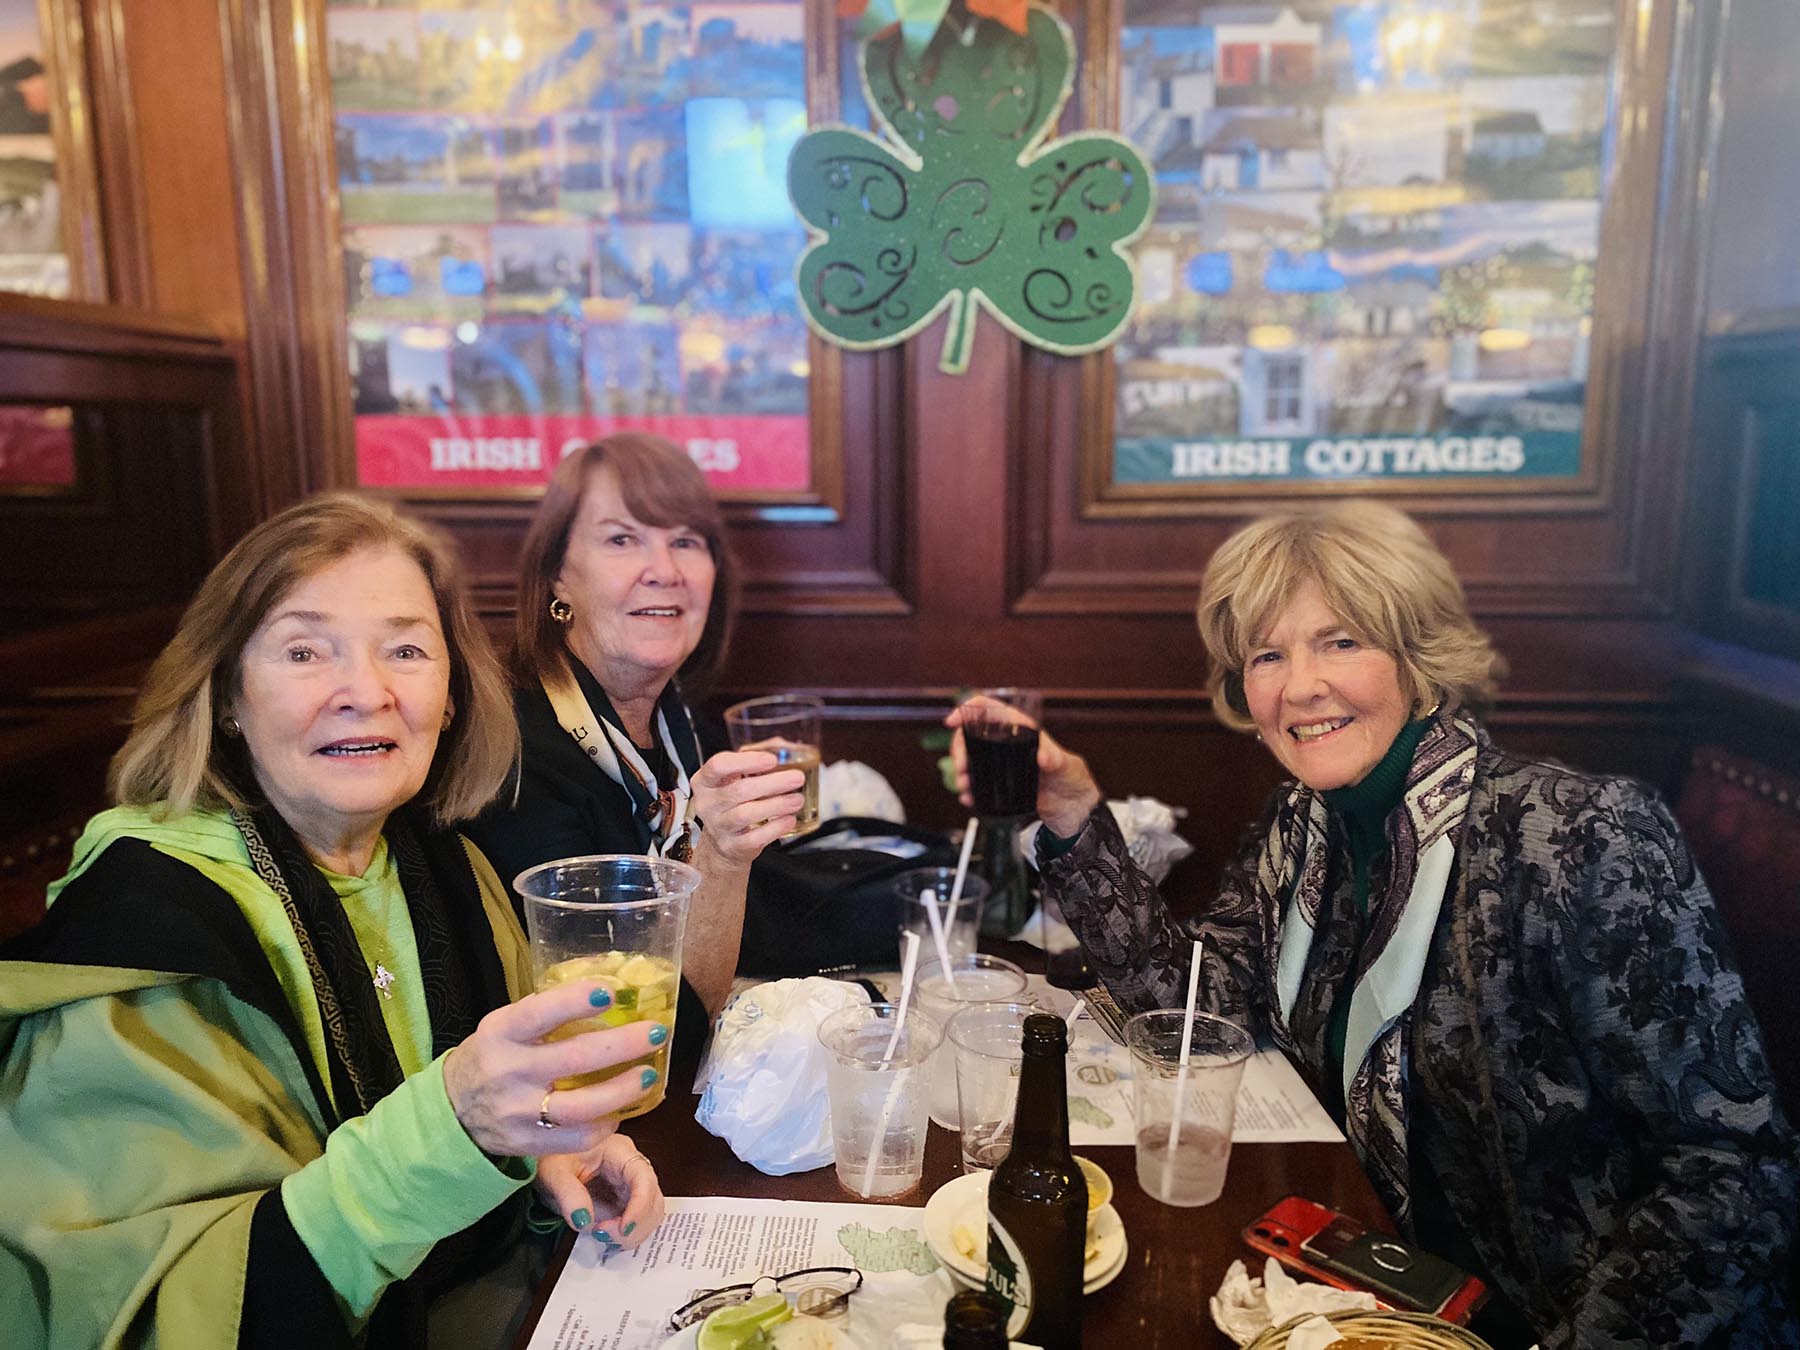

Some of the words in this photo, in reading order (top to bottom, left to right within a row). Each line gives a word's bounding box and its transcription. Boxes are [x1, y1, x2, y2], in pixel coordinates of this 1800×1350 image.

[430, 437, 543, 471] IRISH
[1172, 439, 1291, 476] IRISH
[1305, 436, 1525, 473] COTTAGES
